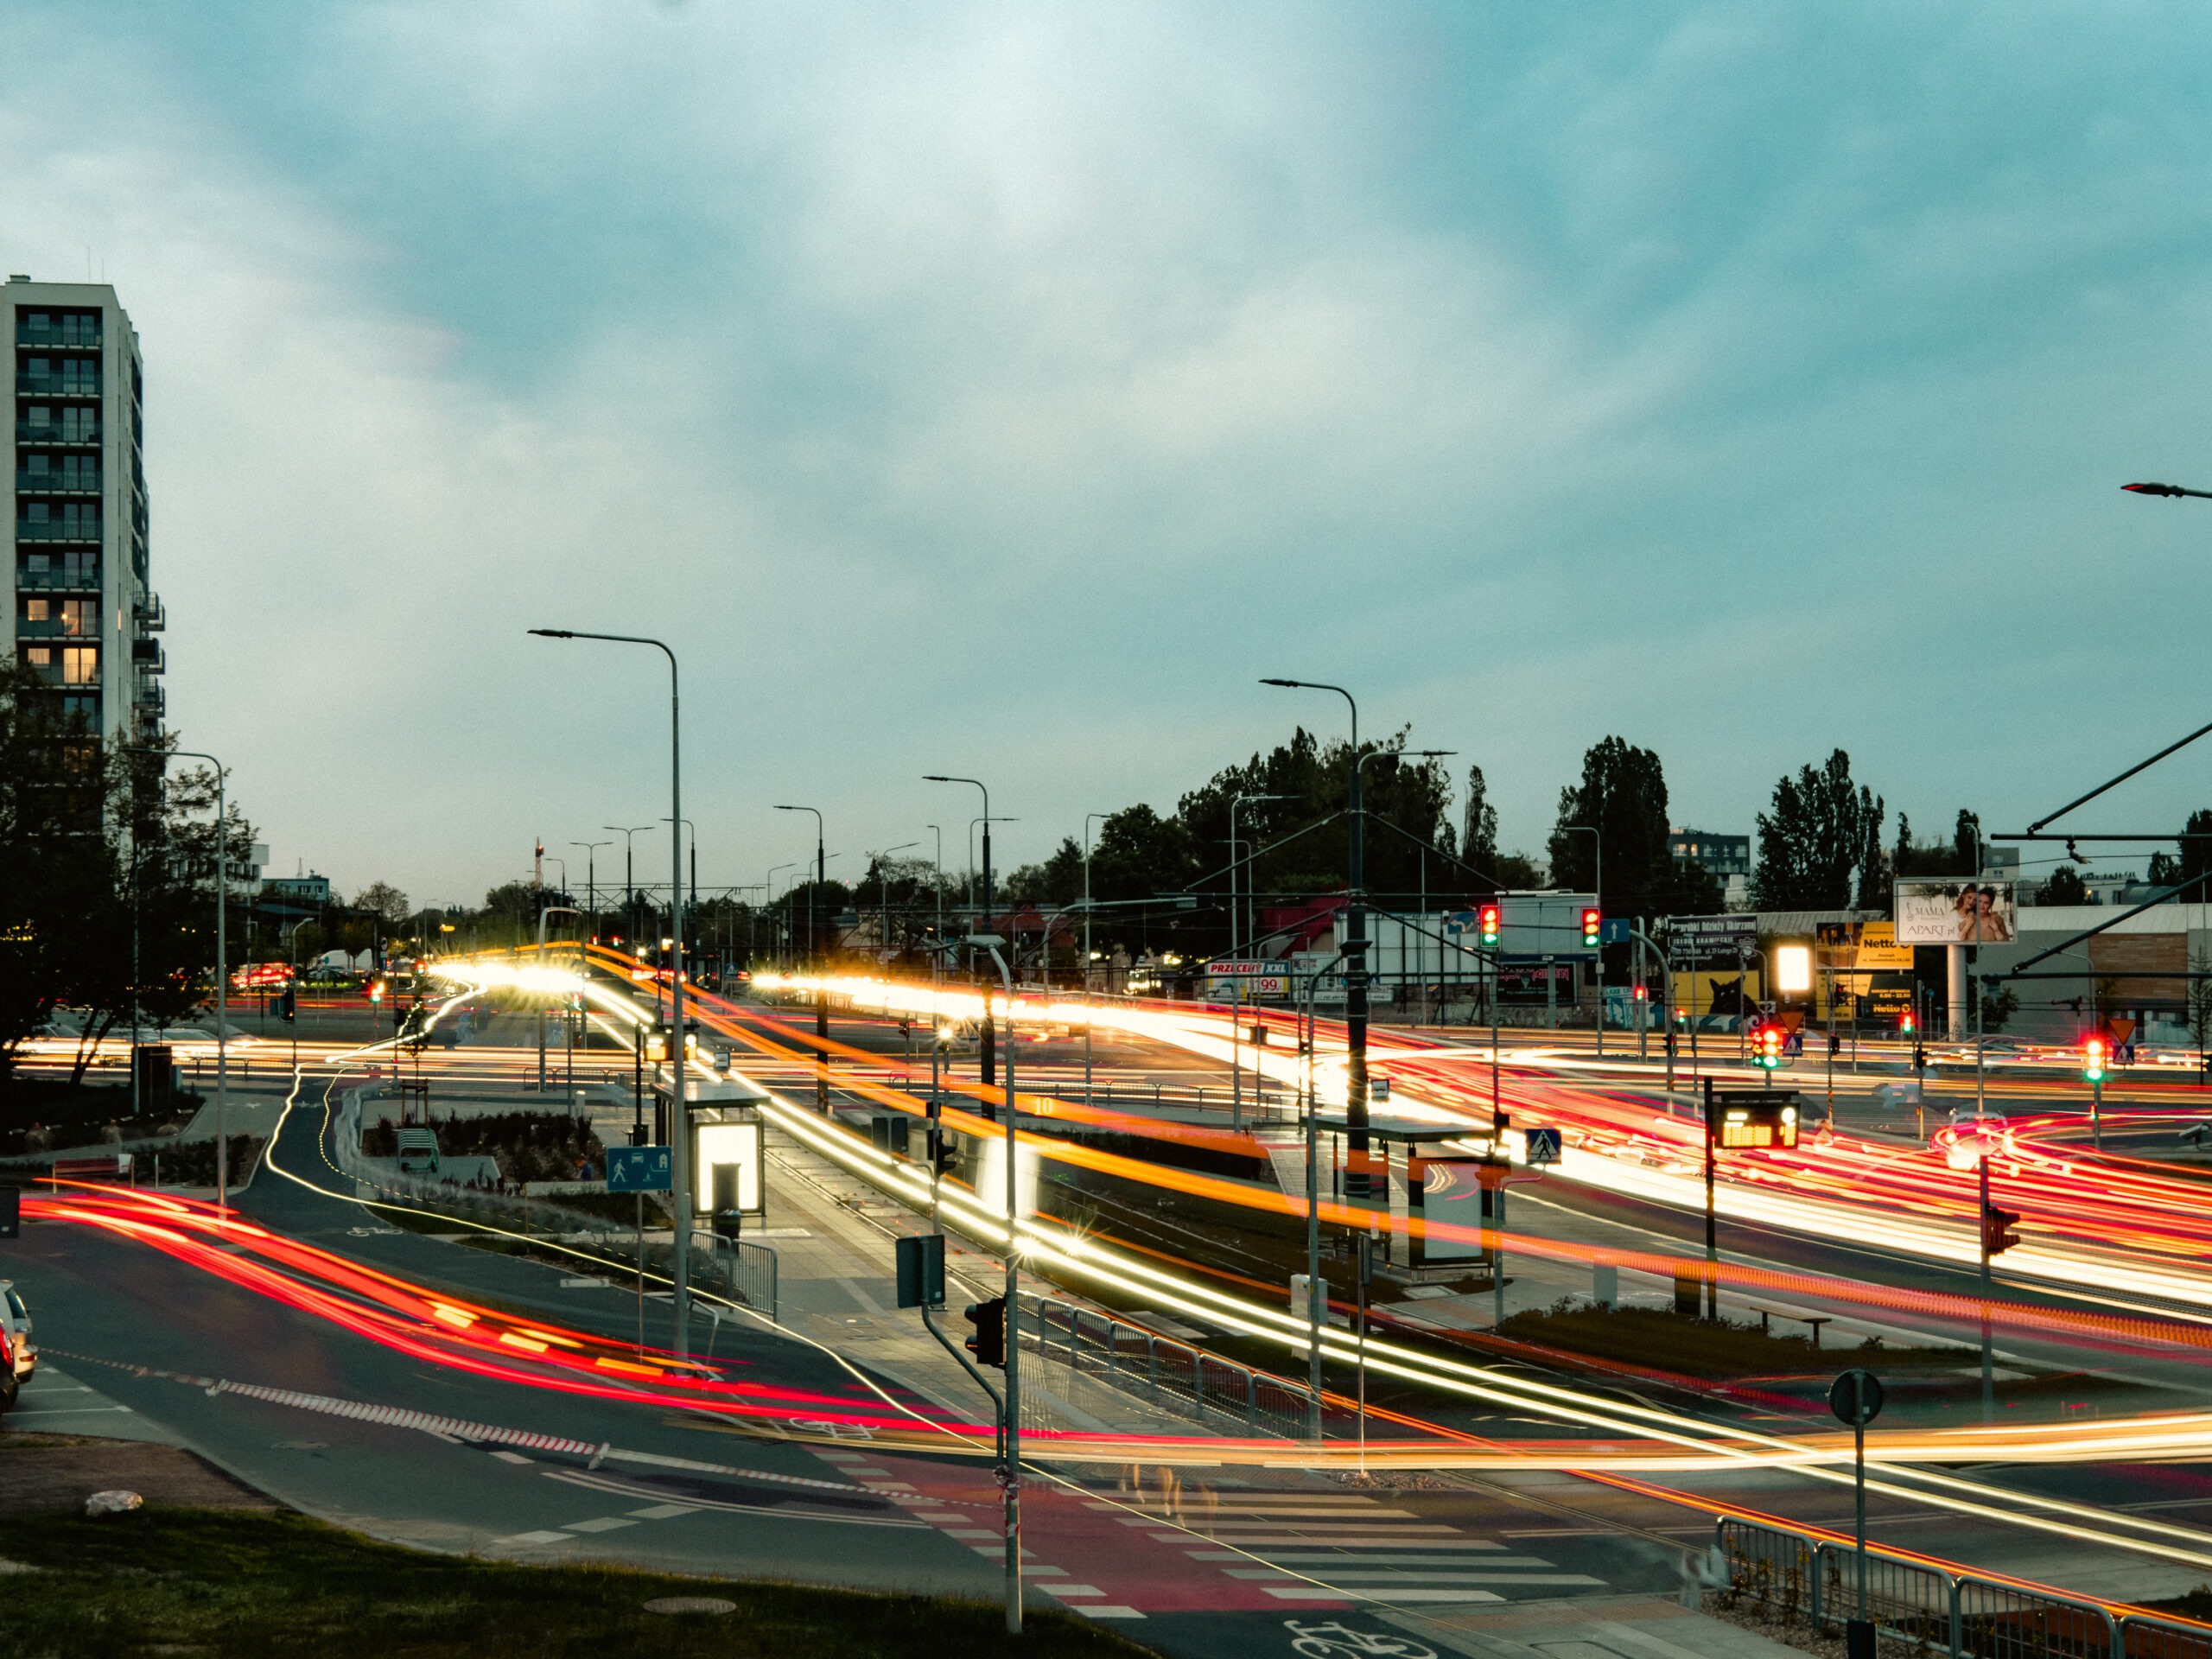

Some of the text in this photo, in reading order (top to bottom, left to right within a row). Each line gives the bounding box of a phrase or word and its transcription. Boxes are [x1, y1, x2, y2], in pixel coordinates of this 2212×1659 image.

[1915, 906, 1944, 916] MAMA
[1864, 939, 1897, 948] Netto
[1266, 964, 1287, 973] XXL
[1872, 1004, 1900, 1013] Netto
[1034, 1096, 1052, 1115] 10
